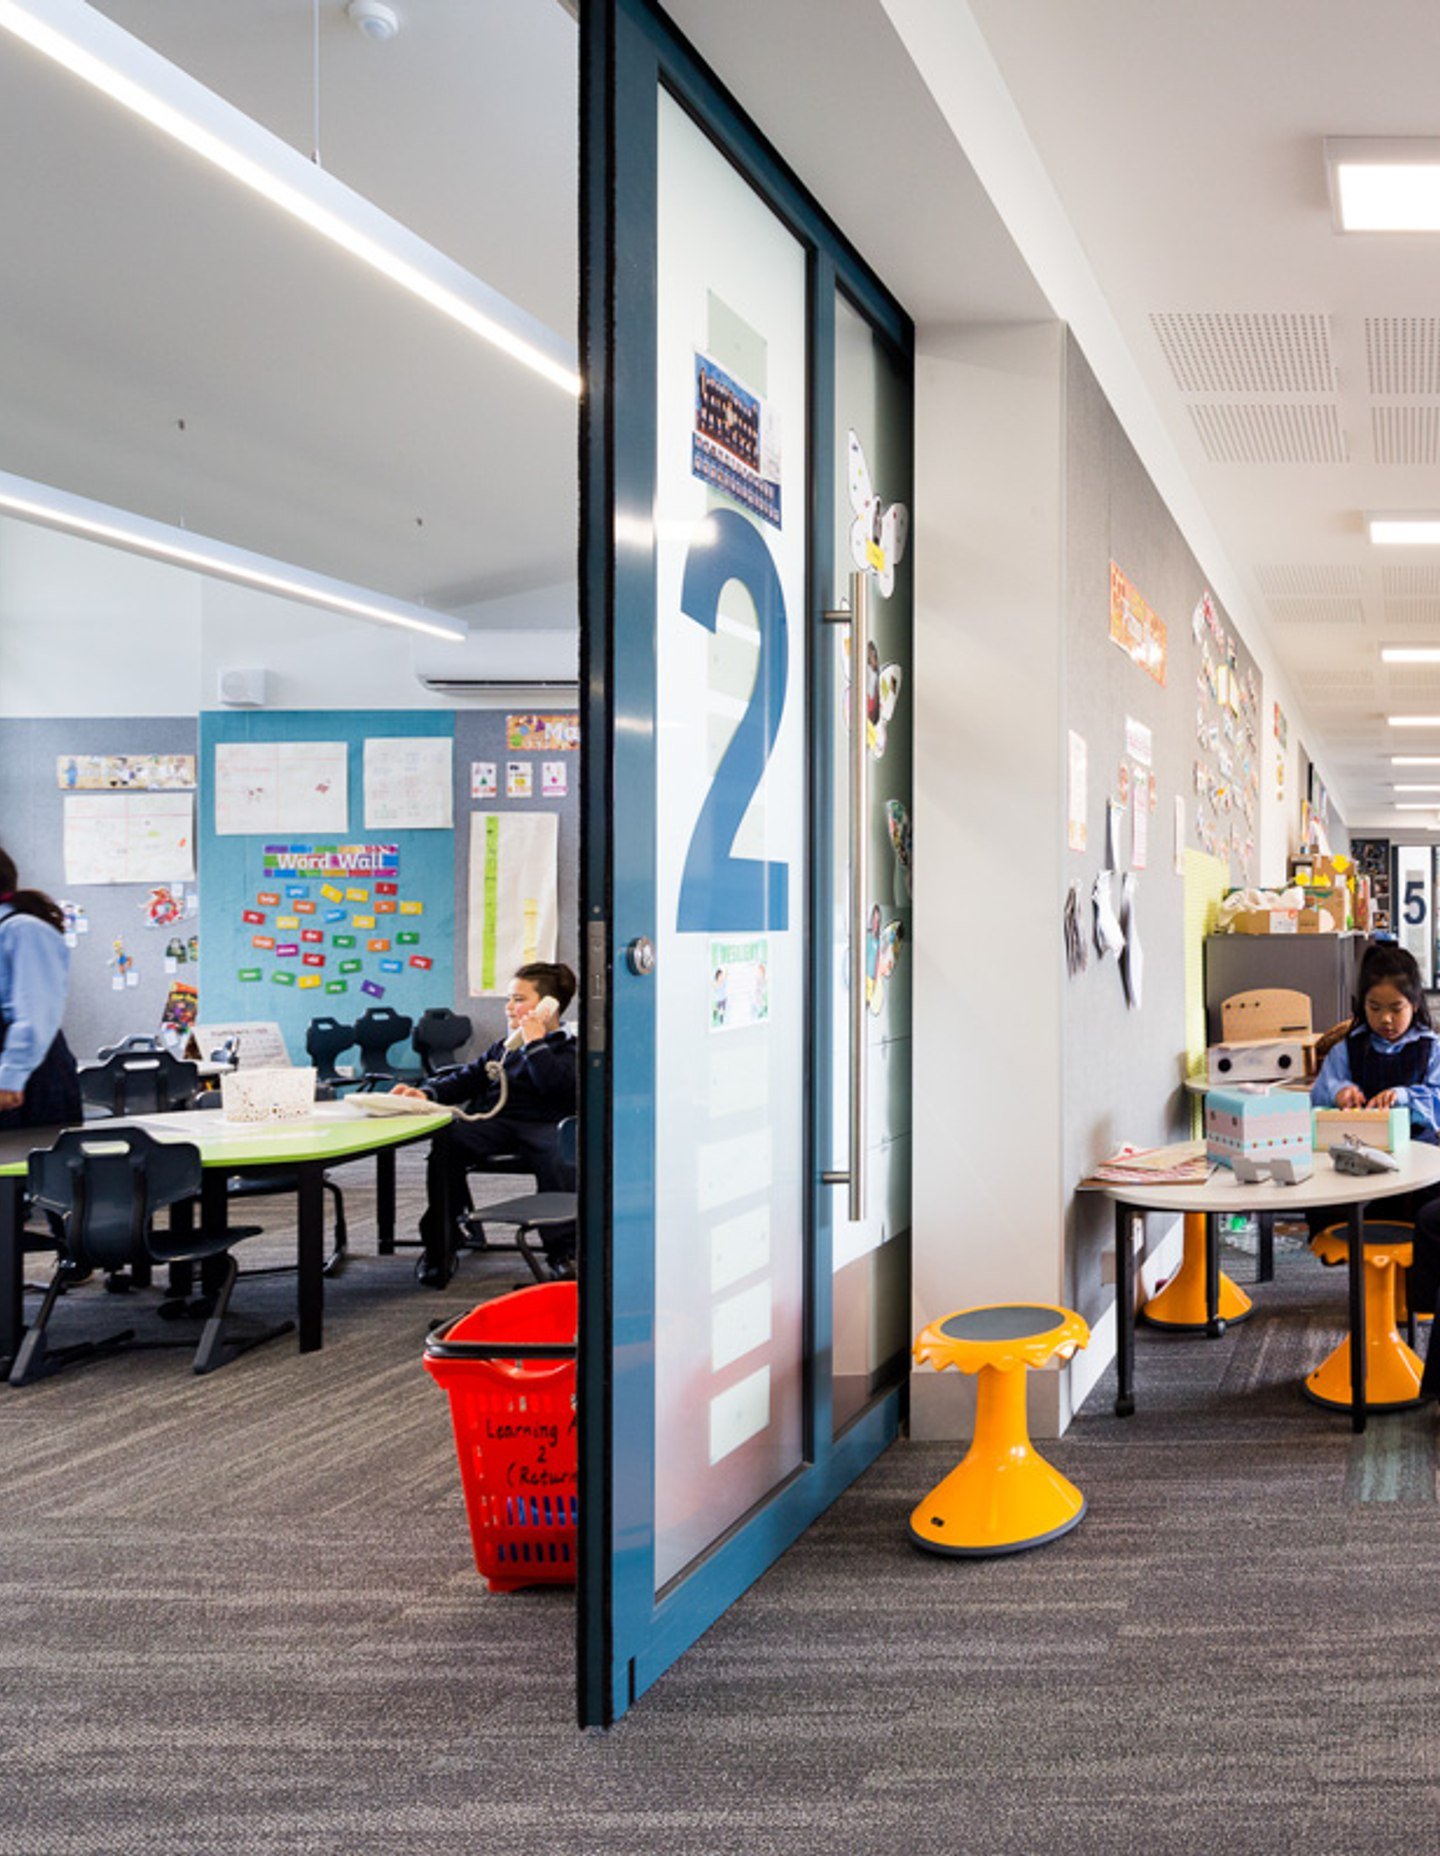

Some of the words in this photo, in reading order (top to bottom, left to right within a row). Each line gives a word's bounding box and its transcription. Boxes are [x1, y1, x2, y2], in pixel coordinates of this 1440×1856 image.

[676, 507, 789, 933] 2
[277, 852, 331, 869] Word
[338, 852, 384, 869] Wall
[1402, 881, 1427, 925] 5
[486, 1418, 559, 1448] Learning
[537, 1445, 547, 1463] 2
